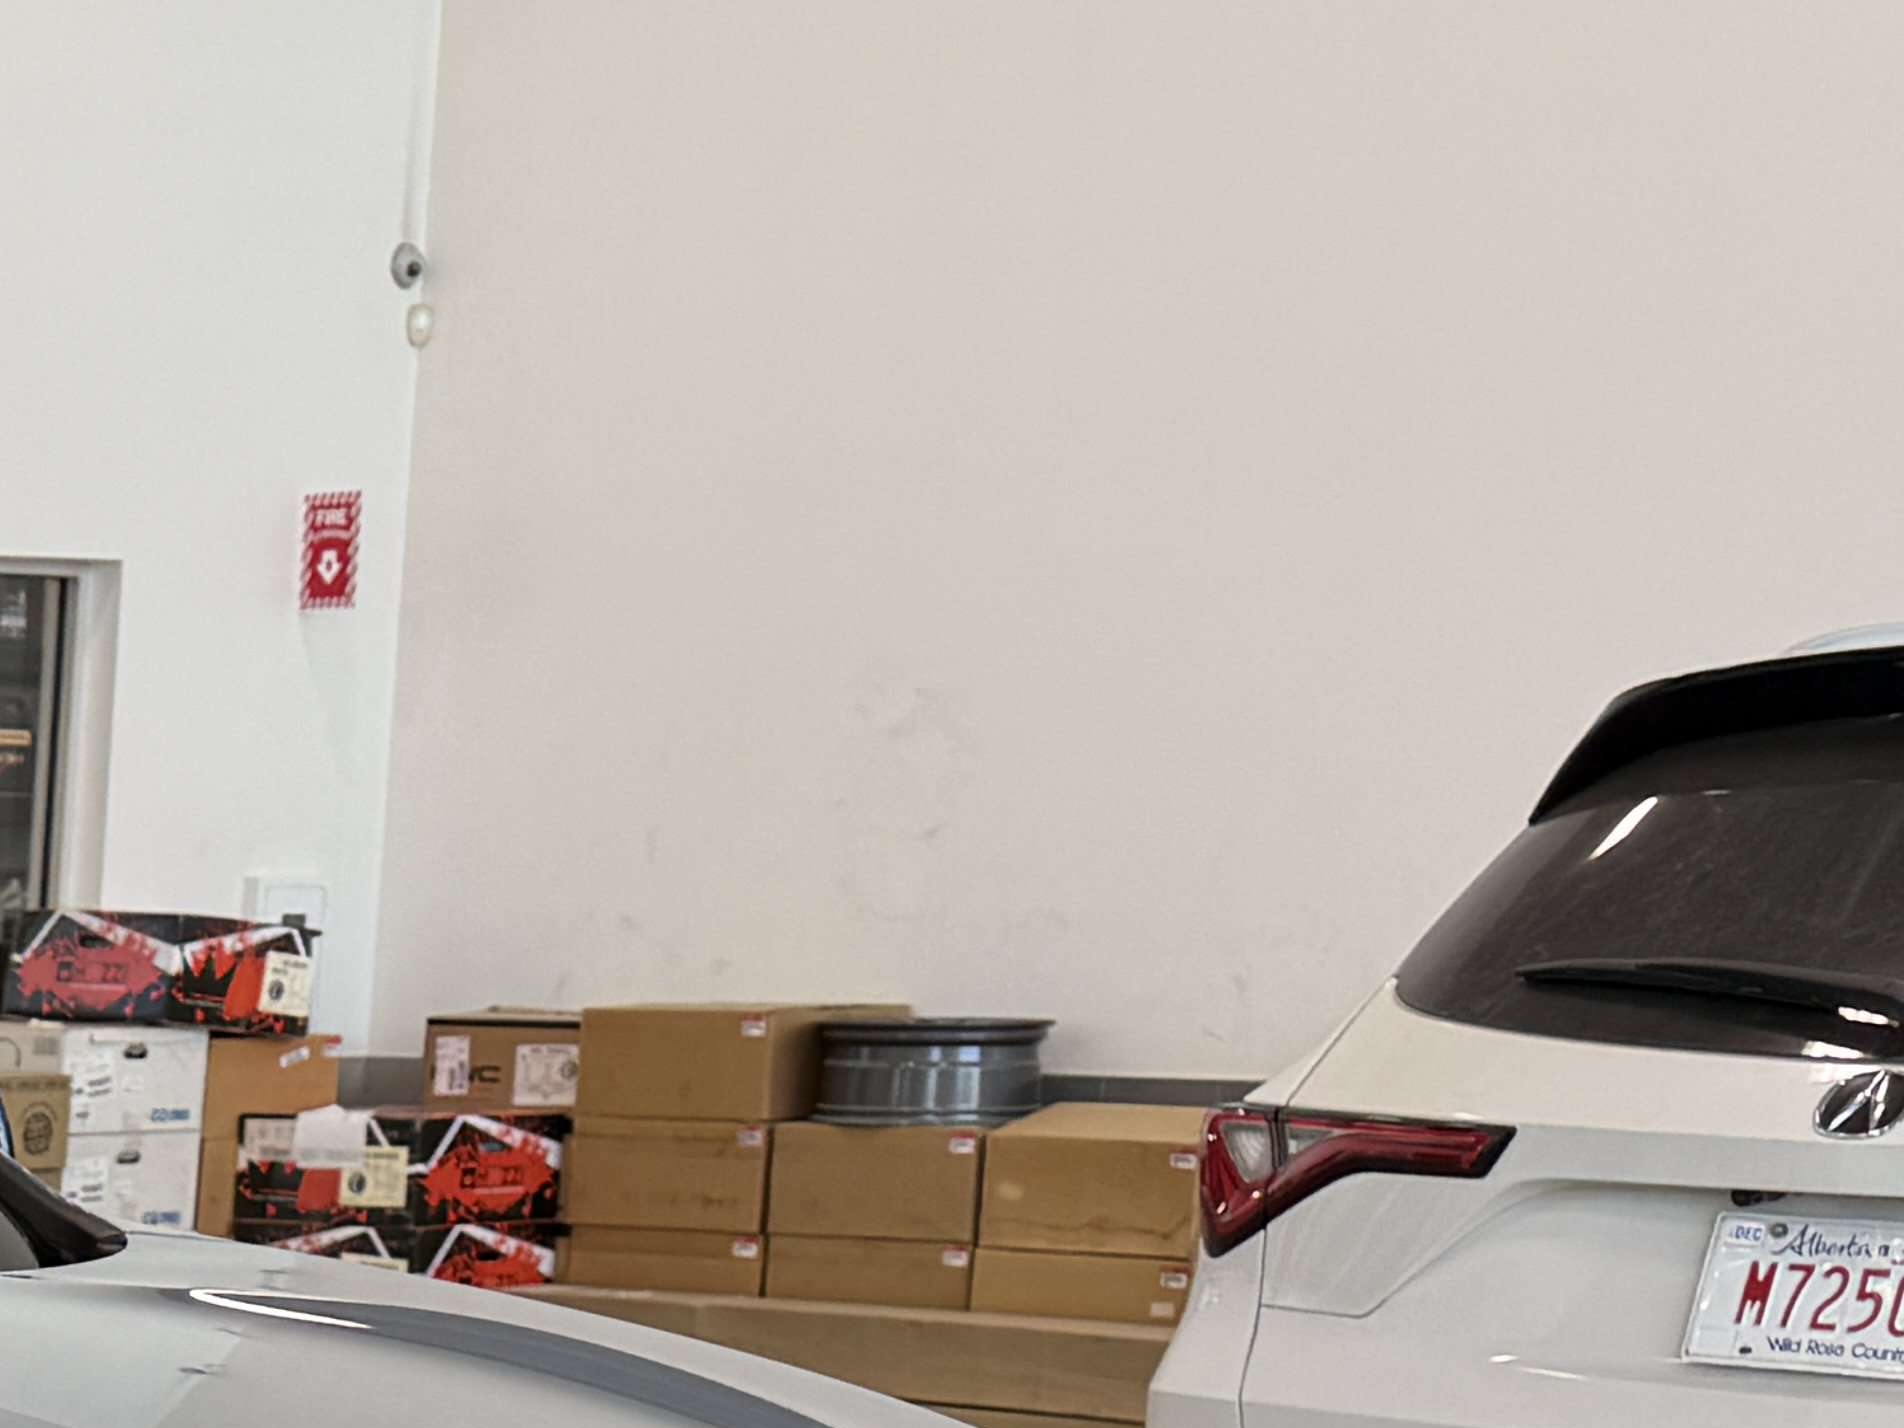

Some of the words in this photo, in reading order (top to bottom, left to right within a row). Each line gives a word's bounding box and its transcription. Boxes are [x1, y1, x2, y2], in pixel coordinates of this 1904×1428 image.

[1771, 1223, 1873, 1258] Alberta
[1767, 1336, 1802, 1351] Wild
[1805, 1339, 1845, 1358] Rose
